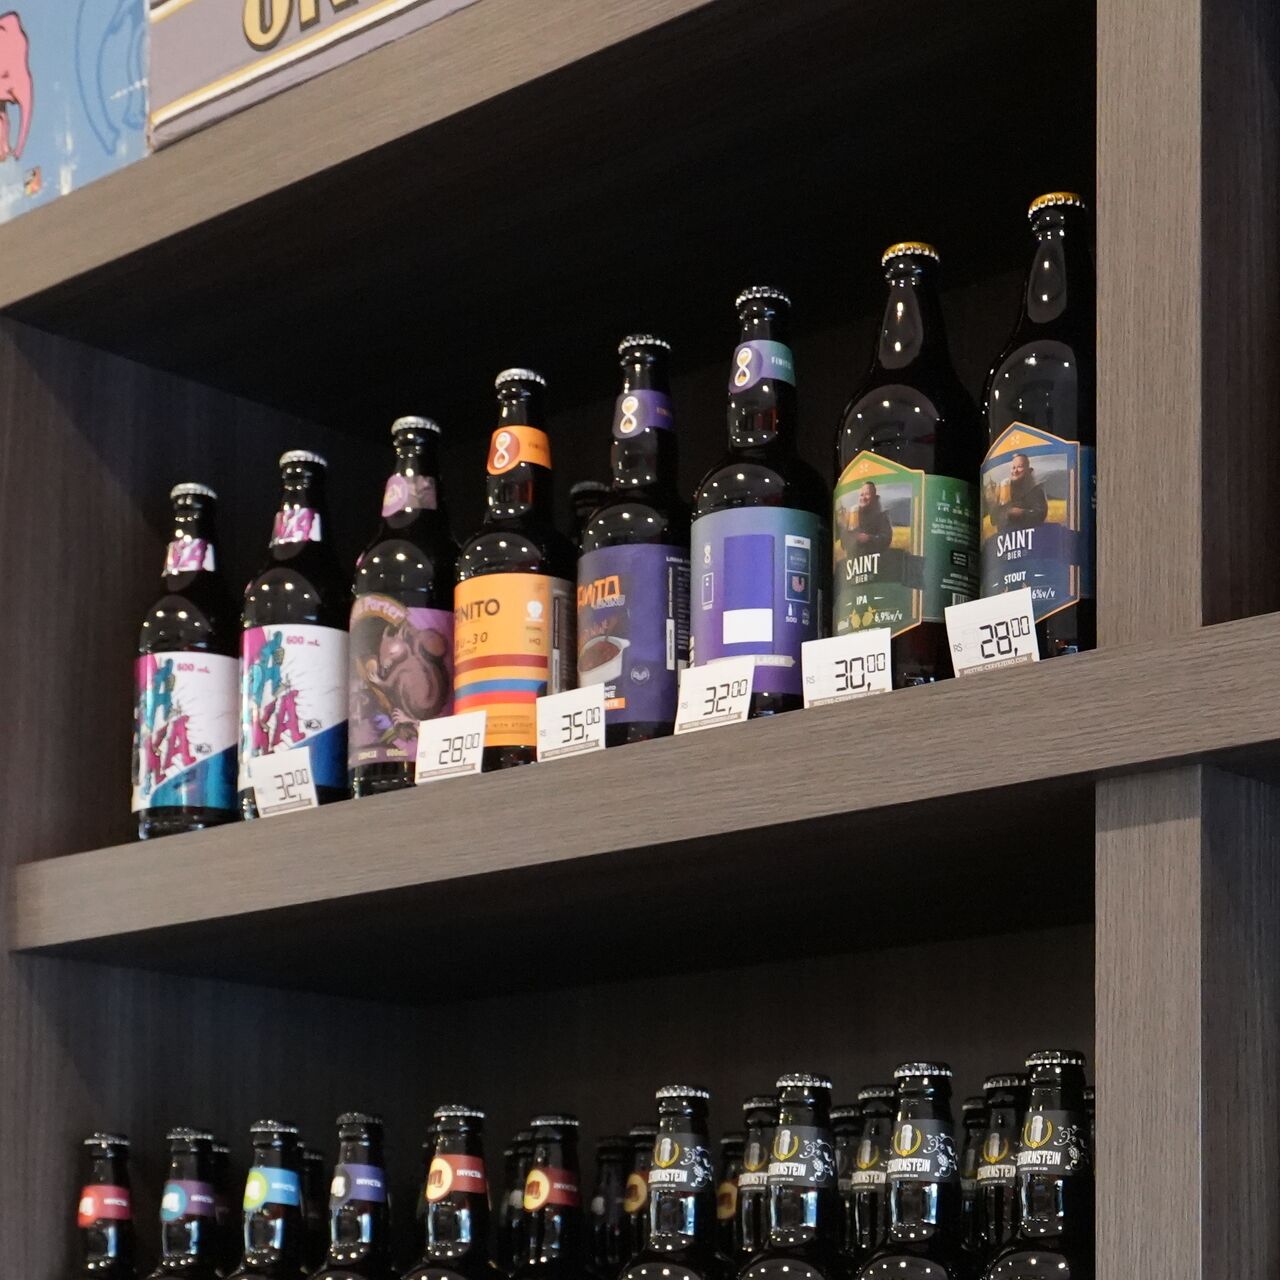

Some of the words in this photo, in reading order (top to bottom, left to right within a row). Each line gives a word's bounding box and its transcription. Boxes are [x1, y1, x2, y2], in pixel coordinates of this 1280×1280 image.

[996, 528, 1035, 558] SAINT
[1007, 550, 1022, 561] BIER
[846, 553, 881, 581] SAINT
[855, 574, 868, 585] BIER
[1003, 571, 1027, 585] STOUT
[856, 596, 868, 606] IPA
[979, 615, 1030, 659] 28,00
[834, 652, 886, 692] 30,00
[702, 678, 749, 716] 32,00
[560, 706, 601, 744] 35,00
[438, 732, 481, 766] 28,00
